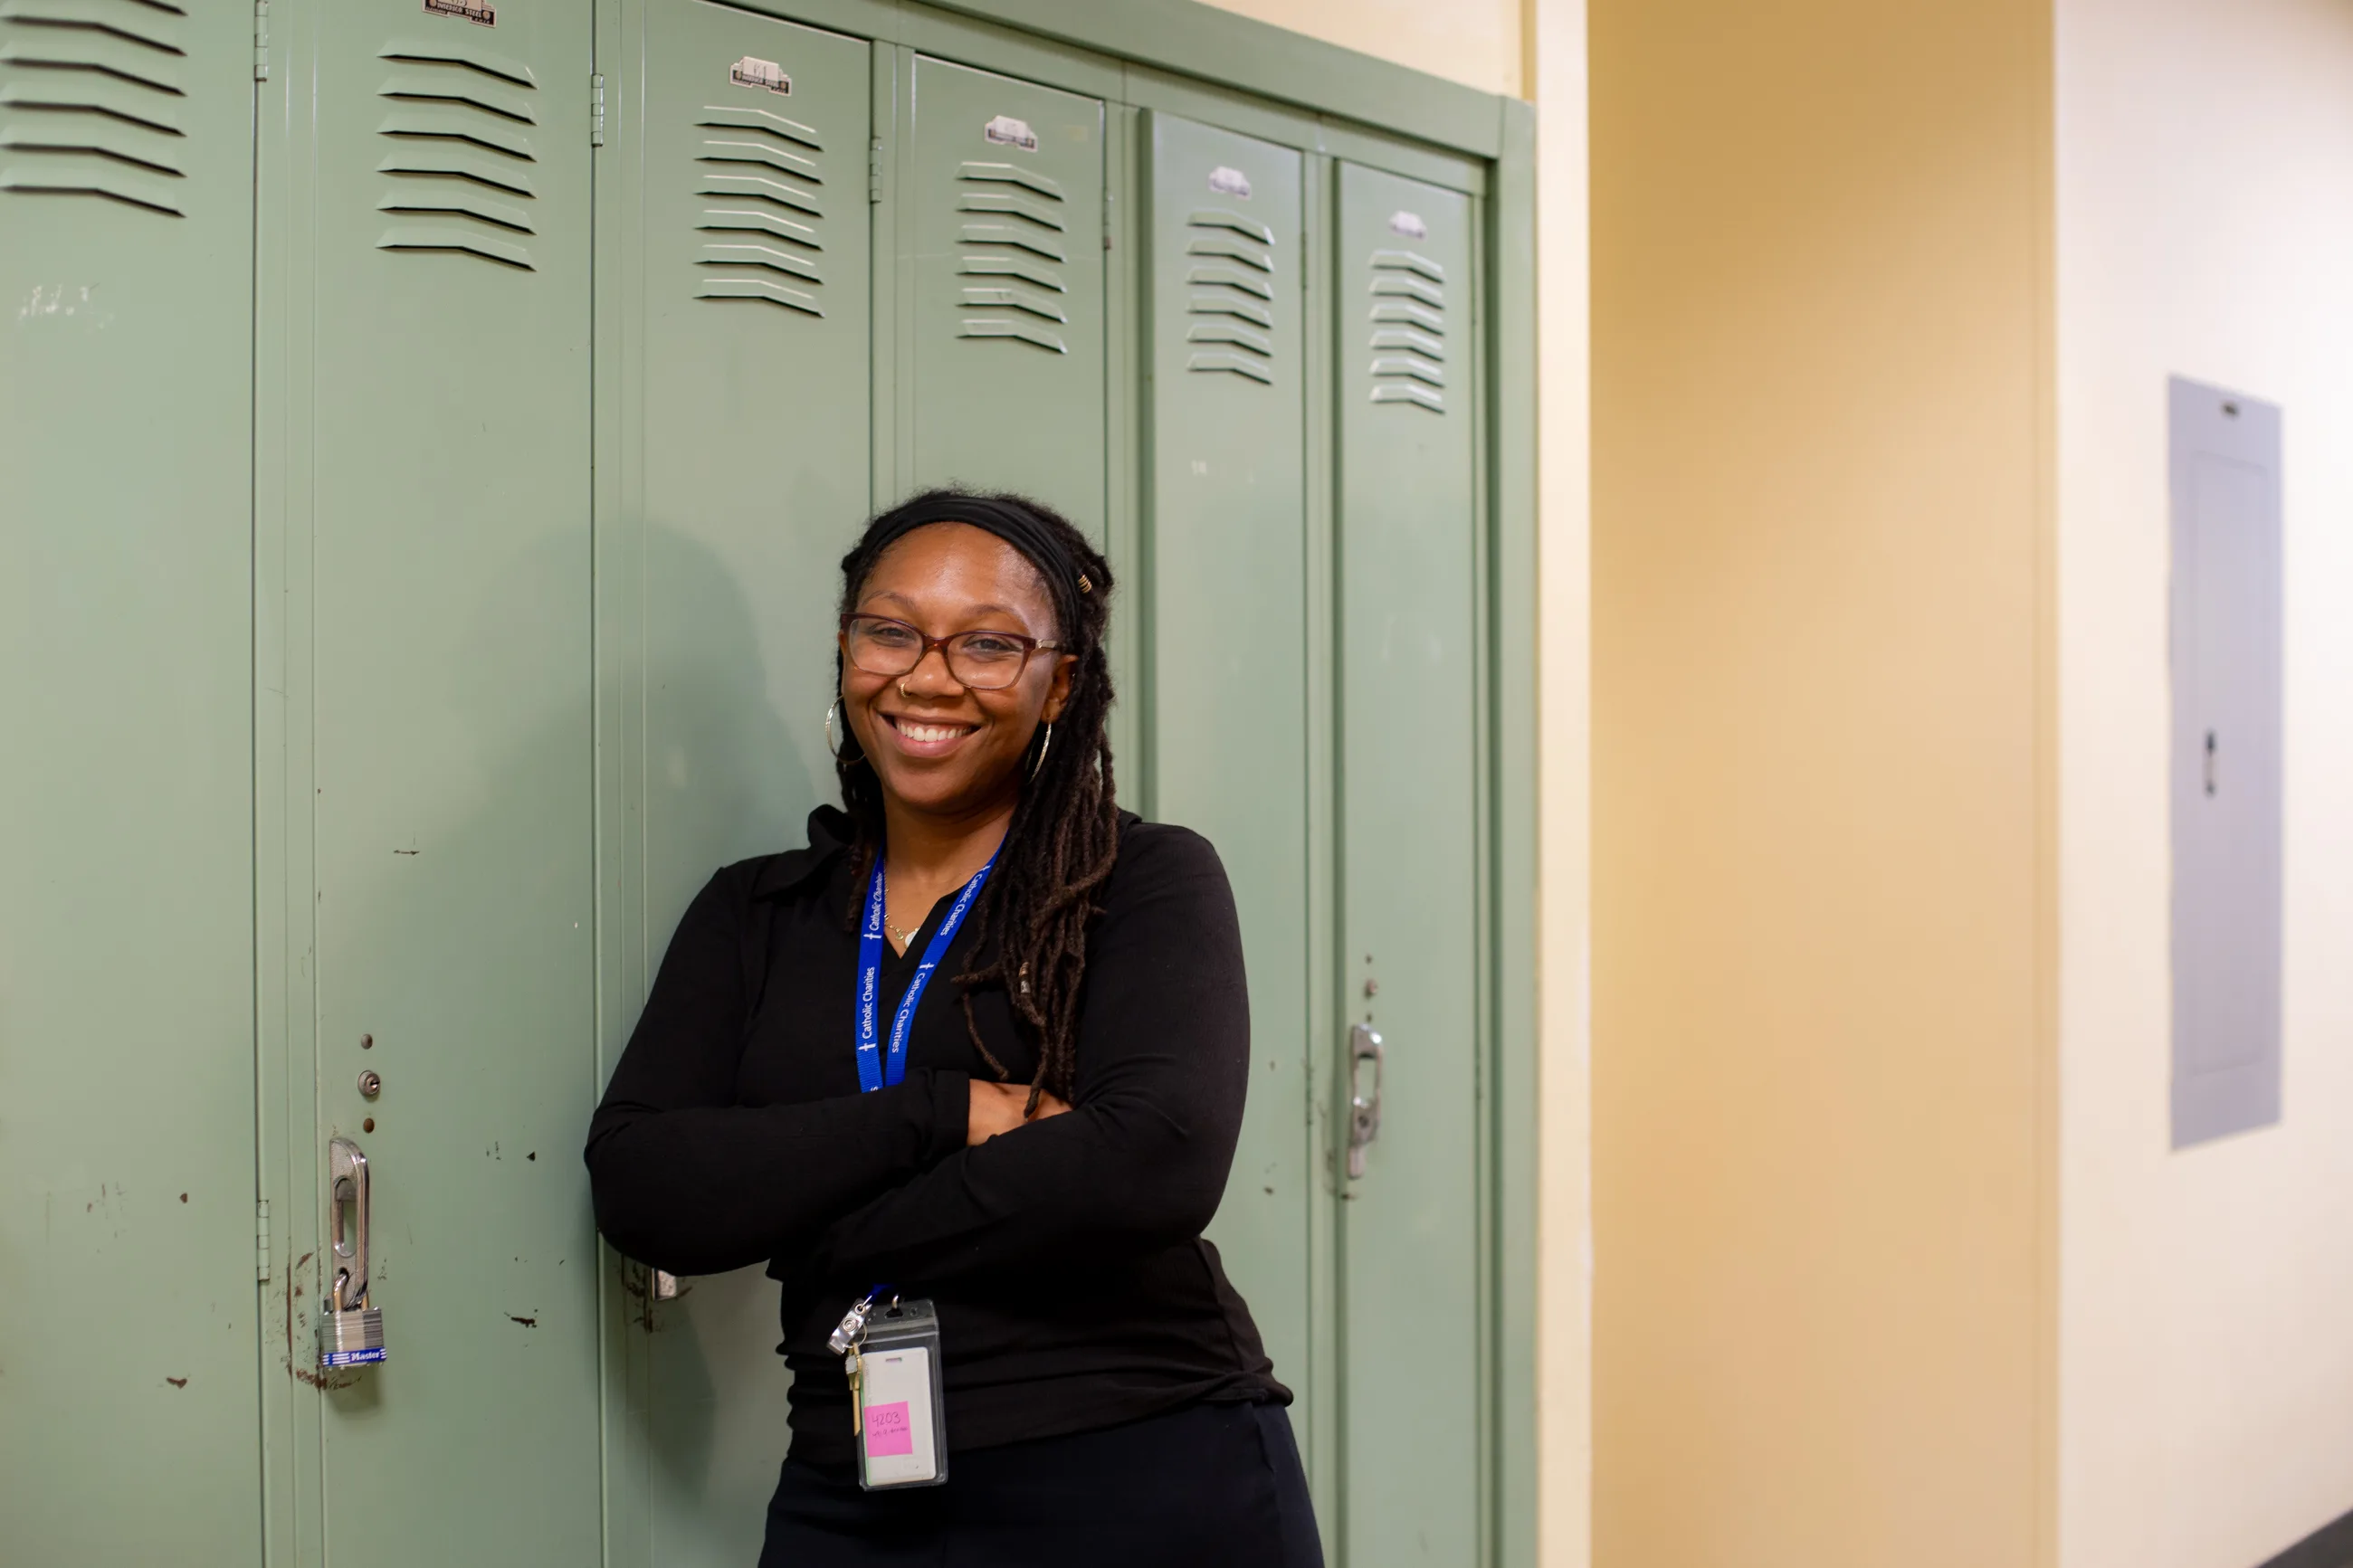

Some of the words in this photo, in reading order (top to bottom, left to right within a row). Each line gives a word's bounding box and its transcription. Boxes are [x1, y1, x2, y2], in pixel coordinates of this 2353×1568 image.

[437, 3, 463, 14] INTERIOR
[465, 9, 482, 18] STEEL
[959, 874, 983, 903] Catholic
[869, 901, 881, 931] Catholic
[940, 904, 966, 936] Charities
[862, 966, 875, 1002] Charities
[903, 973, 926, 1008] Catholic
[862, 1002, 872, 1040] Catholic
[891, 1009, 910, 1053] Charities
[350, 1351, 380, 1362] Master
[872, 1411, 901, 1428] 4203
